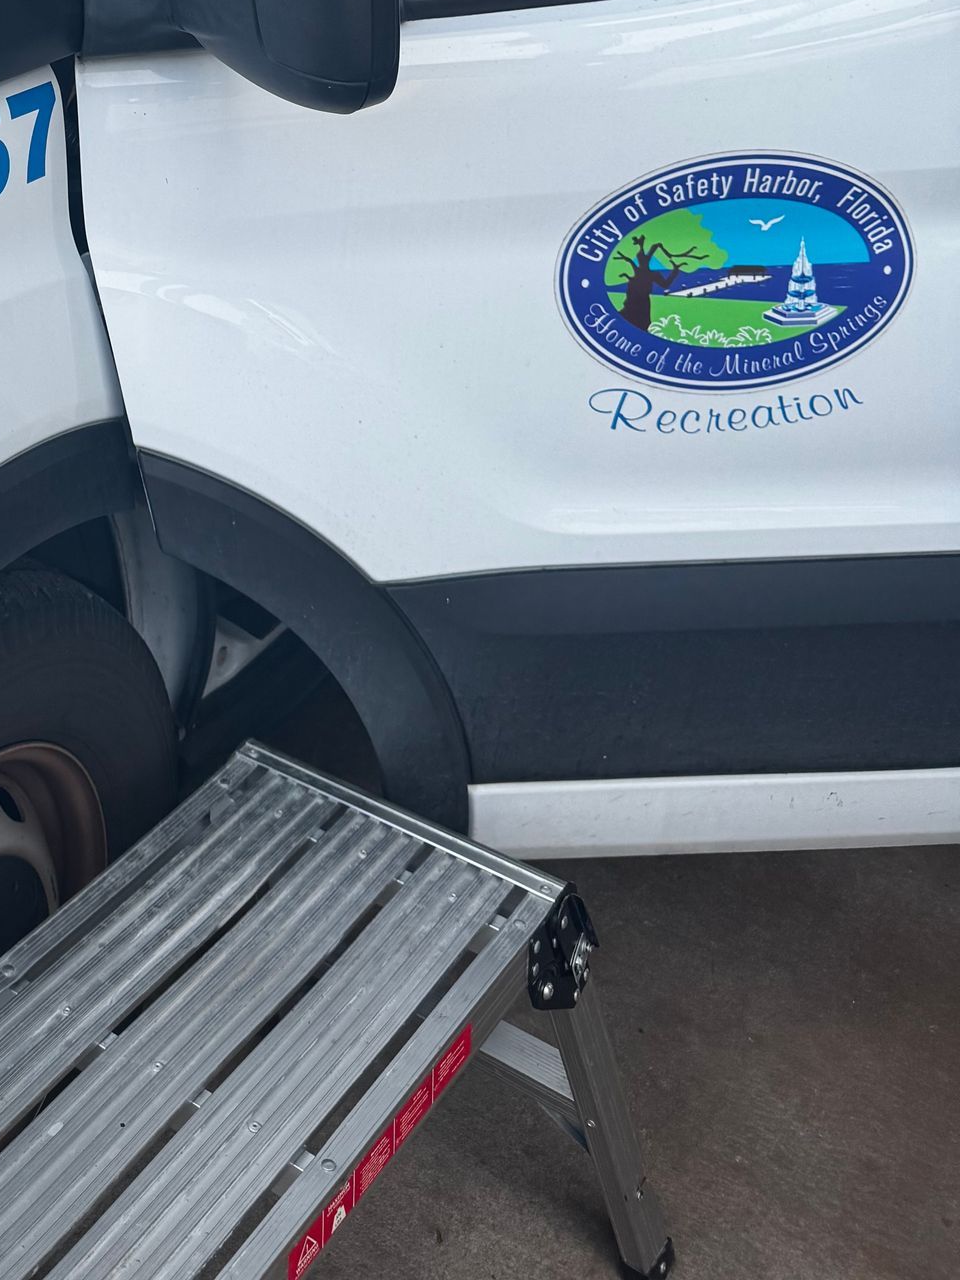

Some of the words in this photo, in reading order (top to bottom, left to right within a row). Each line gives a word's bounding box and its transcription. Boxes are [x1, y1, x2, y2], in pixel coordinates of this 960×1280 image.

[577, 220, 622, 262] City
[624, 195, 649, 222] of
[656, 172, 733, 207] Safety
[743, 168, 822, 202] Harbor,
[836, 185, 893, 255] Florida
[584, 303, 641, 357] Home
[646, 349, 666, 374] of
[674, 353, 703, 375] the
[709, 341, 804, 377] Mineral
[809, 294, 888, 356] Springs
[588, 387, 864, 435] Recreation
